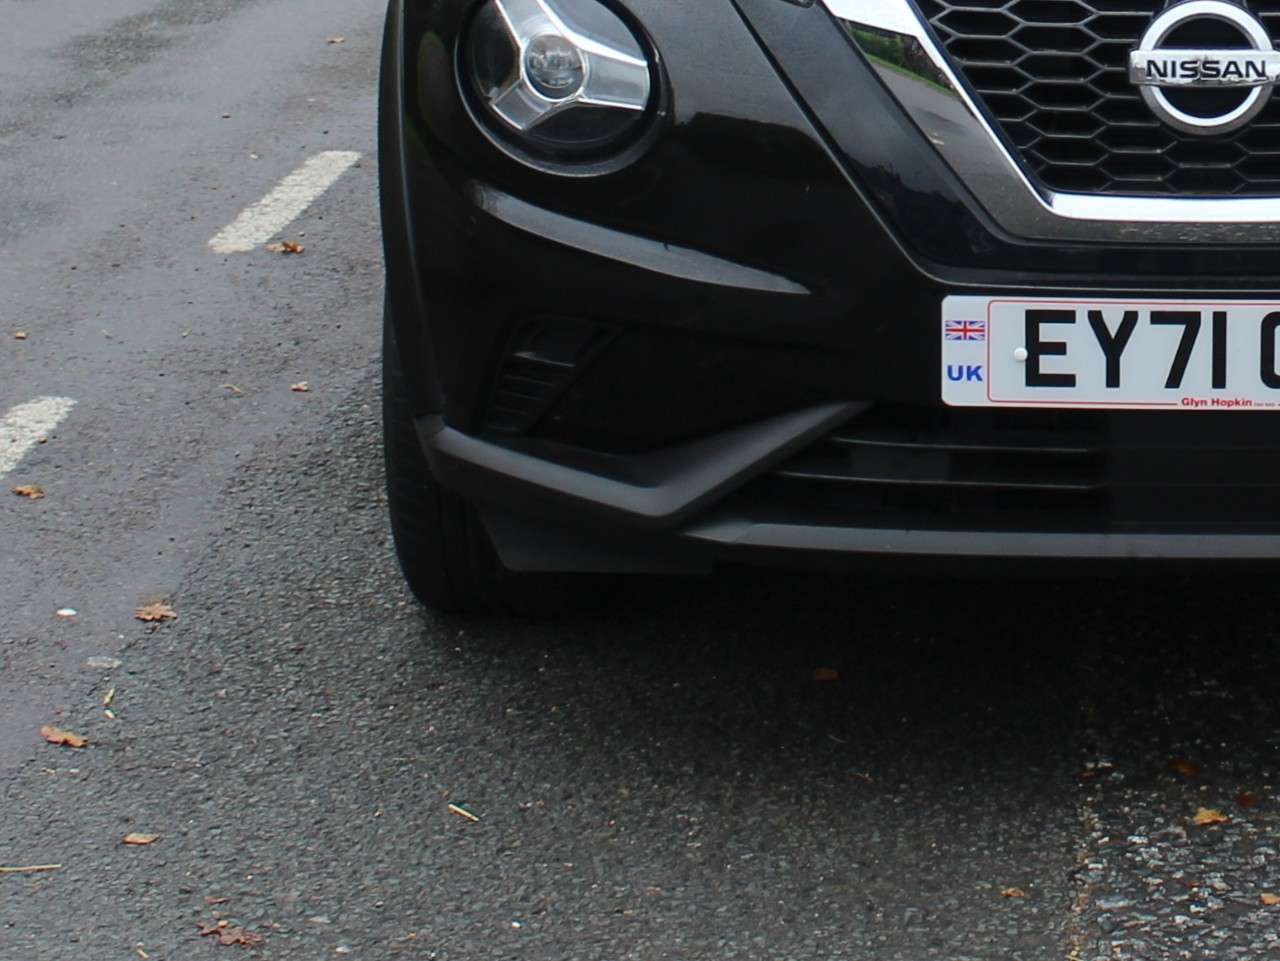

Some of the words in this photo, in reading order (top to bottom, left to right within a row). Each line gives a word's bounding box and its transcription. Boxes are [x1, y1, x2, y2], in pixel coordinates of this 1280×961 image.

[1146, 60, 1266, 78] NISSAN
[1025, 309, 1227, 389] EY71
[946, 364, 983, 382] UK
[1181, 397, 1208, 407] Glyn
[1211, 398, 1253, 408] Hopkin
